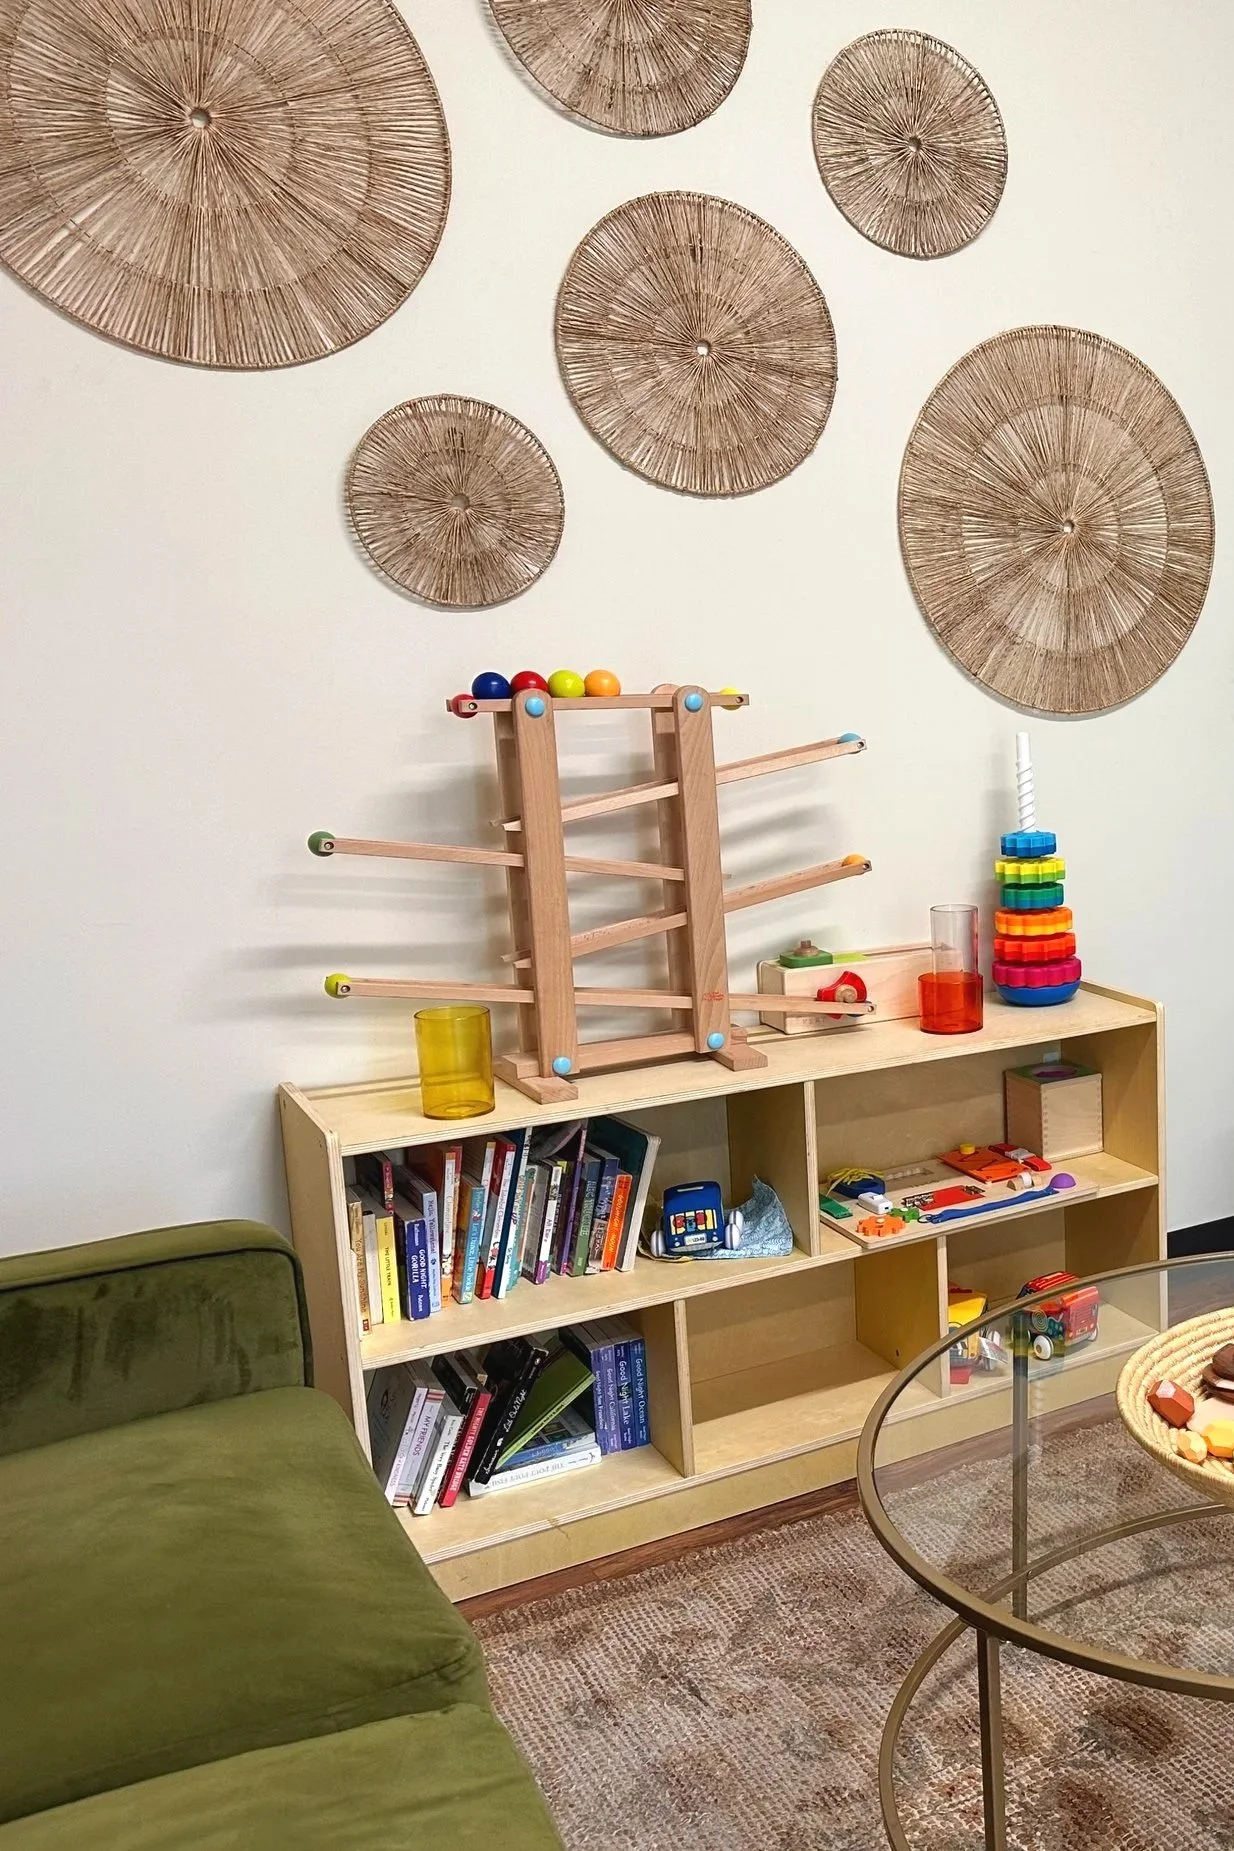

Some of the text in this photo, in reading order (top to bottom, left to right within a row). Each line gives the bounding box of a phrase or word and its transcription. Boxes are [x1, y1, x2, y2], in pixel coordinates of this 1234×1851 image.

[355, 1239, 363, 1252] You
[411, 1255, 420, 1283] GORILLA
[620, 1361, 628, 1380] Good
[620, 1382, 629, 1404] Night
[636, 1378, 645, 1398] Night
[424, 1415, 431, 1427] MY
[609, 1402, 617, 1431] California
[623, 1406, 631, 1424] Lake
[413, 1427, 428, 1457] FRIENDS
